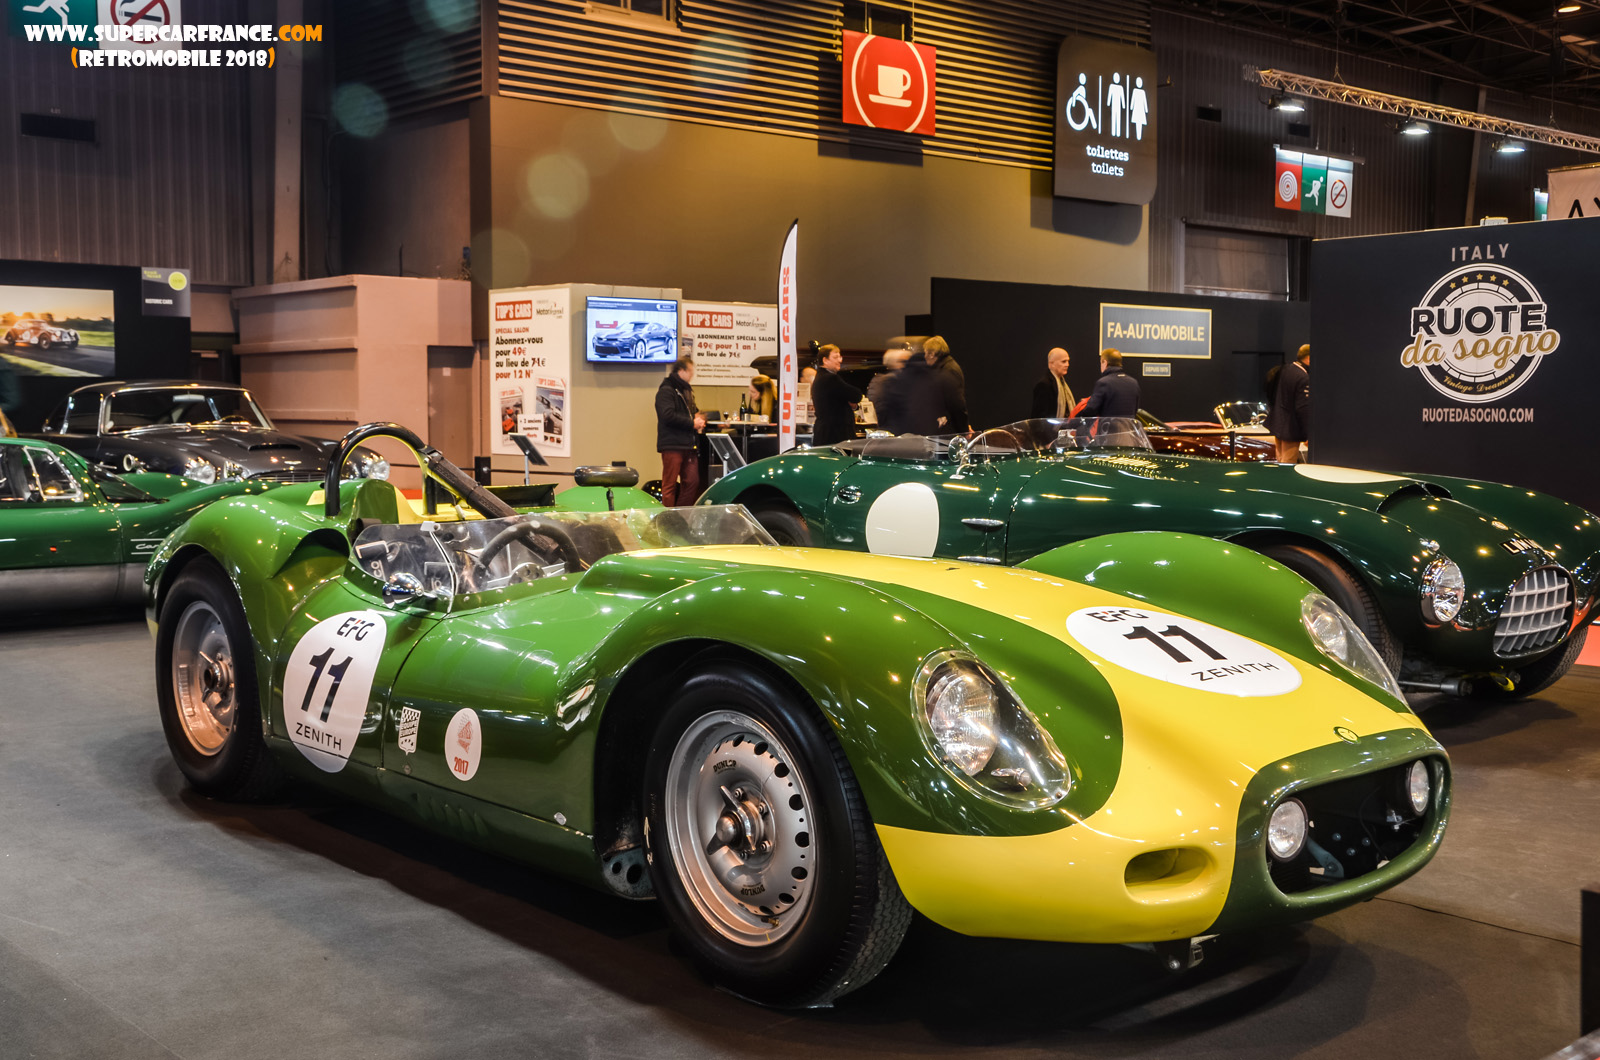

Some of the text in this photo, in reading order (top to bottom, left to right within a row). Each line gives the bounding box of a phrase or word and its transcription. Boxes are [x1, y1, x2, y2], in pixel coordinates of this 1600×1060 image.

[1086, 144, 1129, 161] toilettes
[1091, 162, 1124, 176] toilets
[1451, 243, 1509, 261] ITALY
[496, 303, 532, 319] TOP'S CARS
[1411, 302, 1547, 337] RUOTE
[688, 313, 732, 328] TOP'S CARS
[496, 336, 543, 345] Abonnez-vous
[1107, 322, 1205, 342] FA-AUTOMOBILE
[495, 349, 511, 358] pour
[1401, 329, 1560, 370] da sogno
[506, 358, 518, 367] lieu
[520, 358, 530, 367] de
[495, 372, 511, 381] pour
[1444, 372, 1516, 393] Vintage Dreamers
[1422, 408, 1534, 423] RUOTEDASOGNO.COM
[1086, 609, 1149, 622] EFG
[336, 617, 375, 641] EFG
[1122, 624, 1228, 663] 11
[1191, 662, 1280, 682] ZENITH
[301, 647, 354, 723] 11
[295, 722, 342, 750] ZENITH
[454, 756, 469, 775] 2017
[713, 759, 737, 772] DUNLOP
[740, 884, 766, 896] DUNLOP
